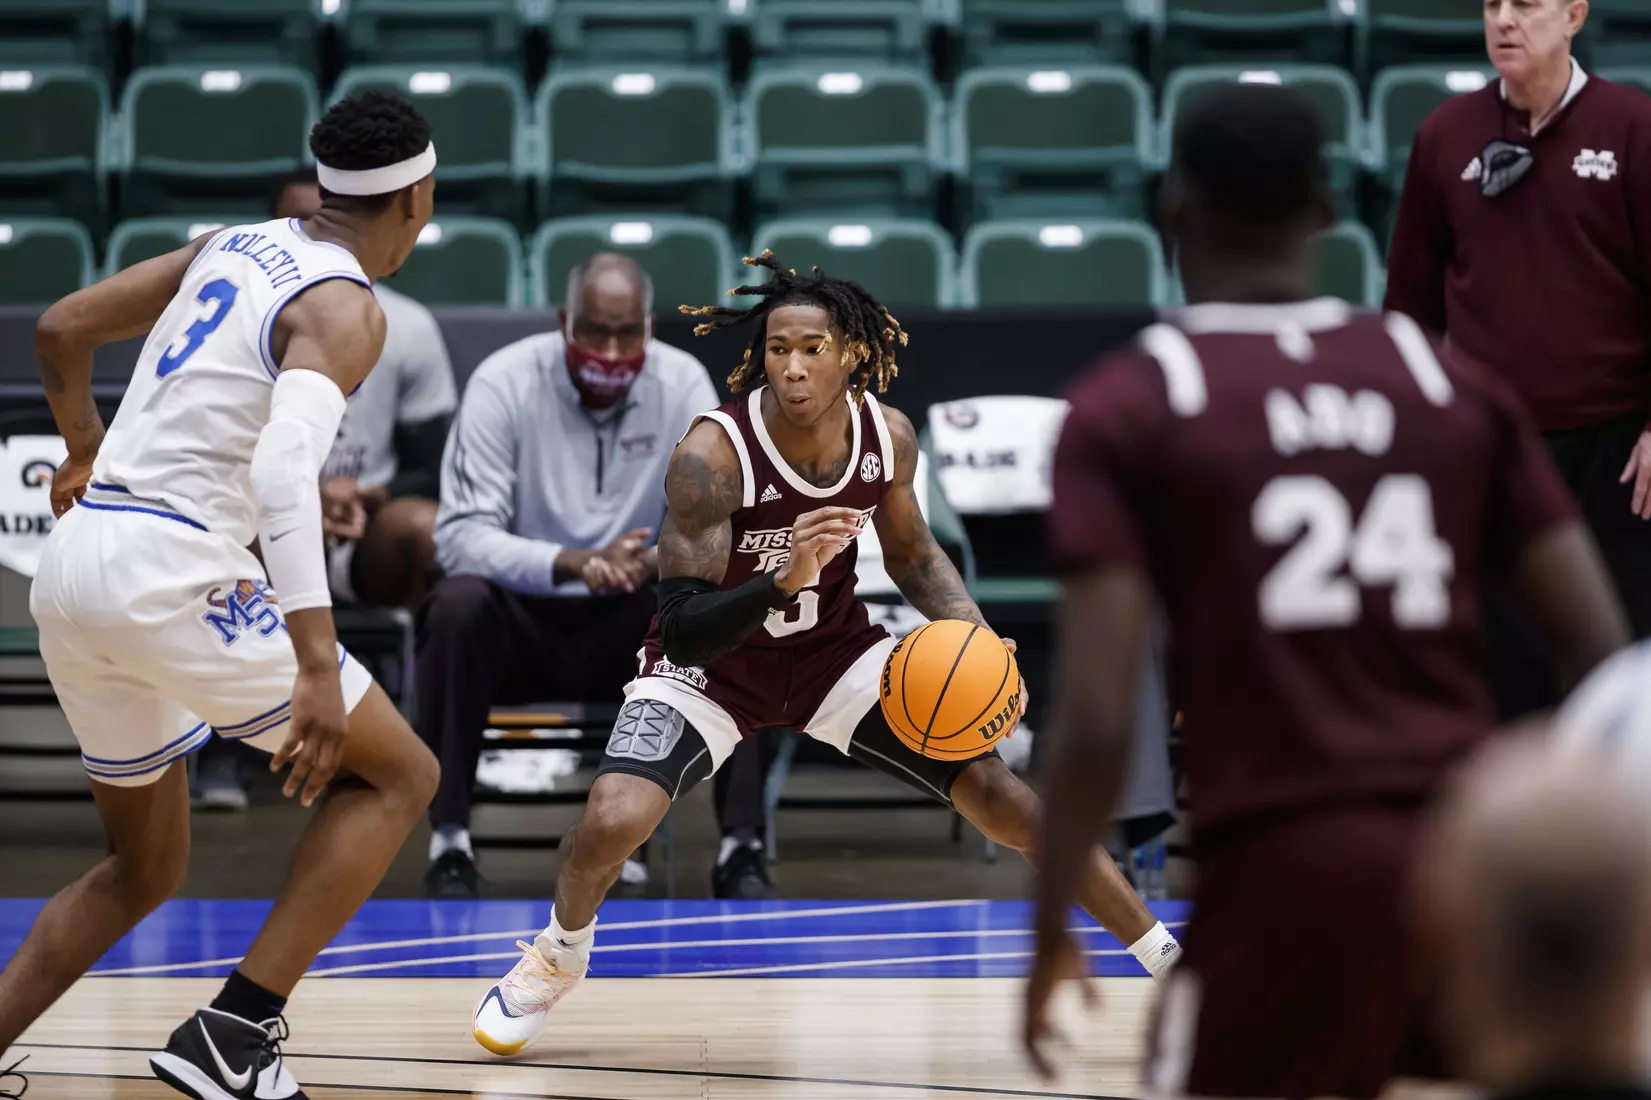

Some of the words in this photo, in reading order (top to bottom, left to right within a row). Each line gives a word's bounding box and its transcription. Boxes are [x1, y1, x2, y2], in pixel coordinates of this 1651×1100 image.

[155, 278, 239, 378] 3
[861, 454, 880, 481] SEC
[760, 492, 783, 503] adidas
[1250, 473, 1455, 632] 24
[202, 591, 287, 647] MS
[662, 664, 699, 683] STATE
[977, 691, 1020, 740] Wils
